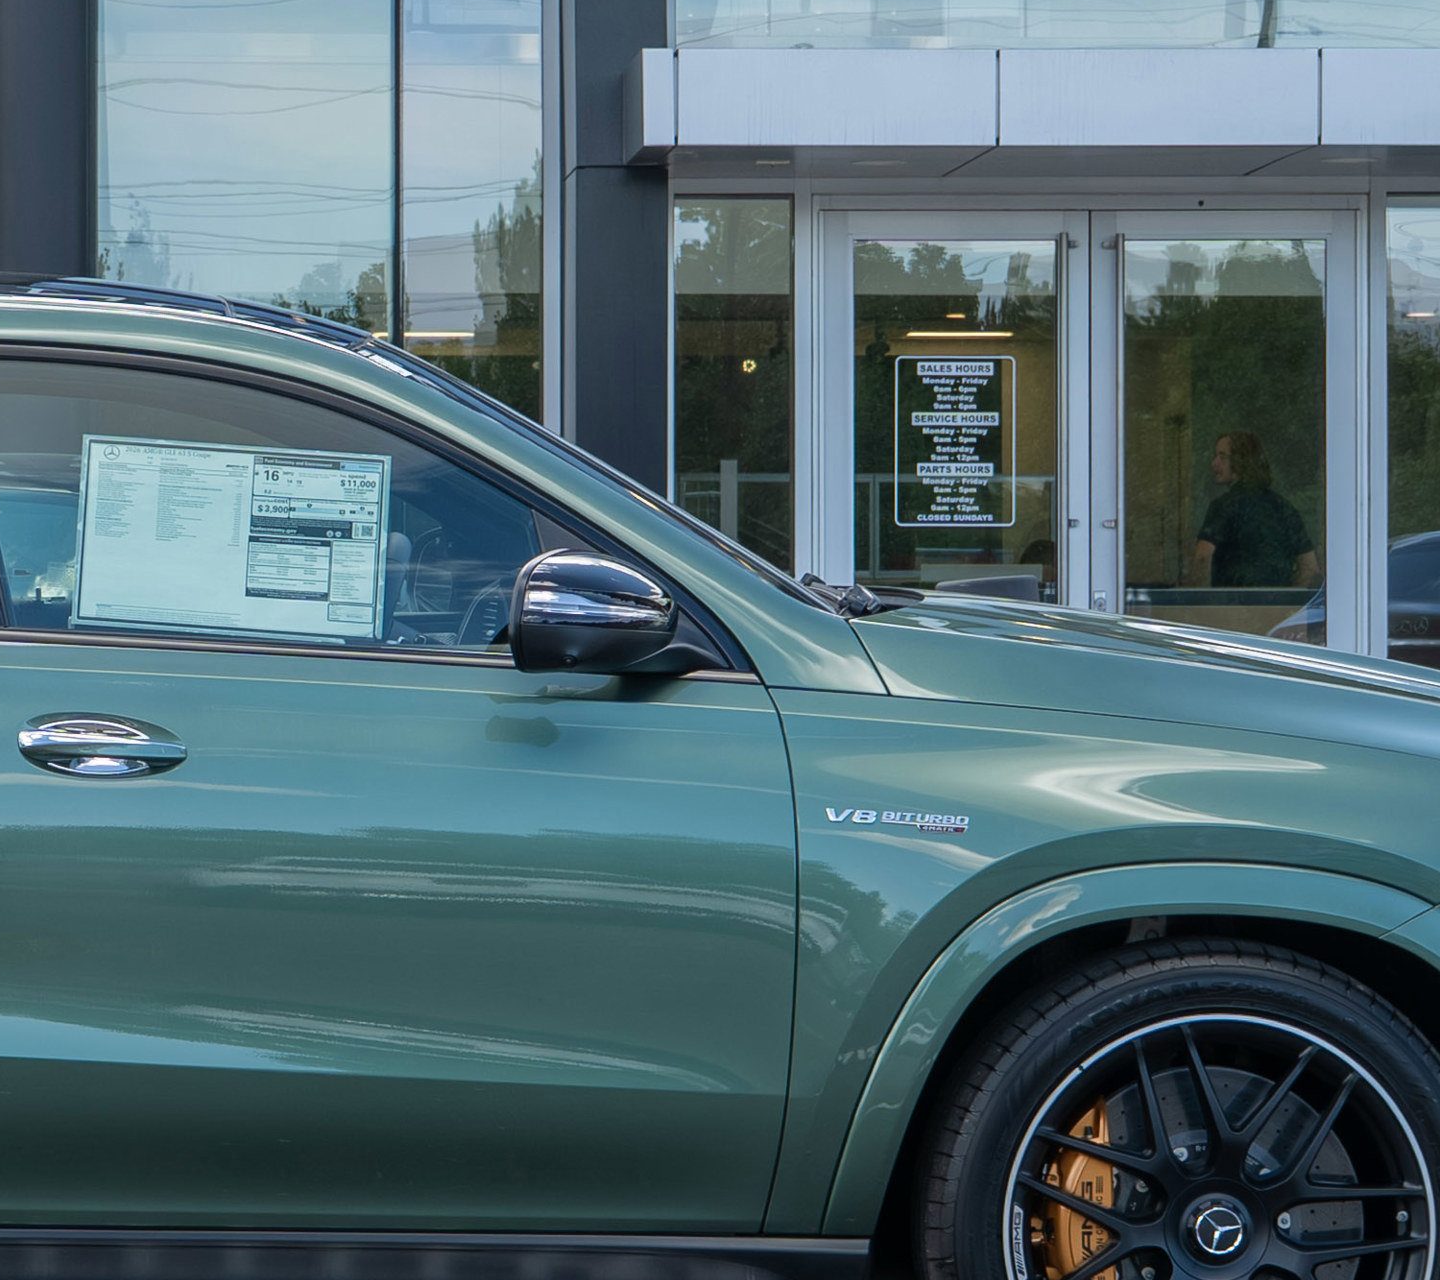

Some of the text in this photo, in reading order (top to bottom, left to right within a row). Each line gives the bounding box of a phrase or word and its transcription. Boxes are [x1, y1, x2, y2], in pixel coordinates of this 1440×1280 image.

[920, 364, 991, 373] SALES HOURS
[922, 377, 955, 386] Monday
[962, 377, 988, 386] Friday
[936, 394, 974, 402] Saturday
[914, 414, 996, 423] SERVICE HOURS
[922, 427, 955, 436] Monday
[962, 427, 988, 436] Friday
[936, 445, 975, 454] Saturday
[956, 453, 979, 462] 12pm
[920, 465, 991, 474] PARTS HOURS
[263, 469, 280, 481] 16
[340, 479, 377, 489] $11,000
[922, 477, 955, 486] Monday
[962, 477, 988, 486] Friday
[936, 496, 975, 504] Saturday
[956, 504, 979, 513] 12pm
[917, 514, 994, 522] CLOSED SUNDAYS
[825, 807, 970, 825] V8 BITURBO
[1012, 1211, 1023, 1257] AMG
